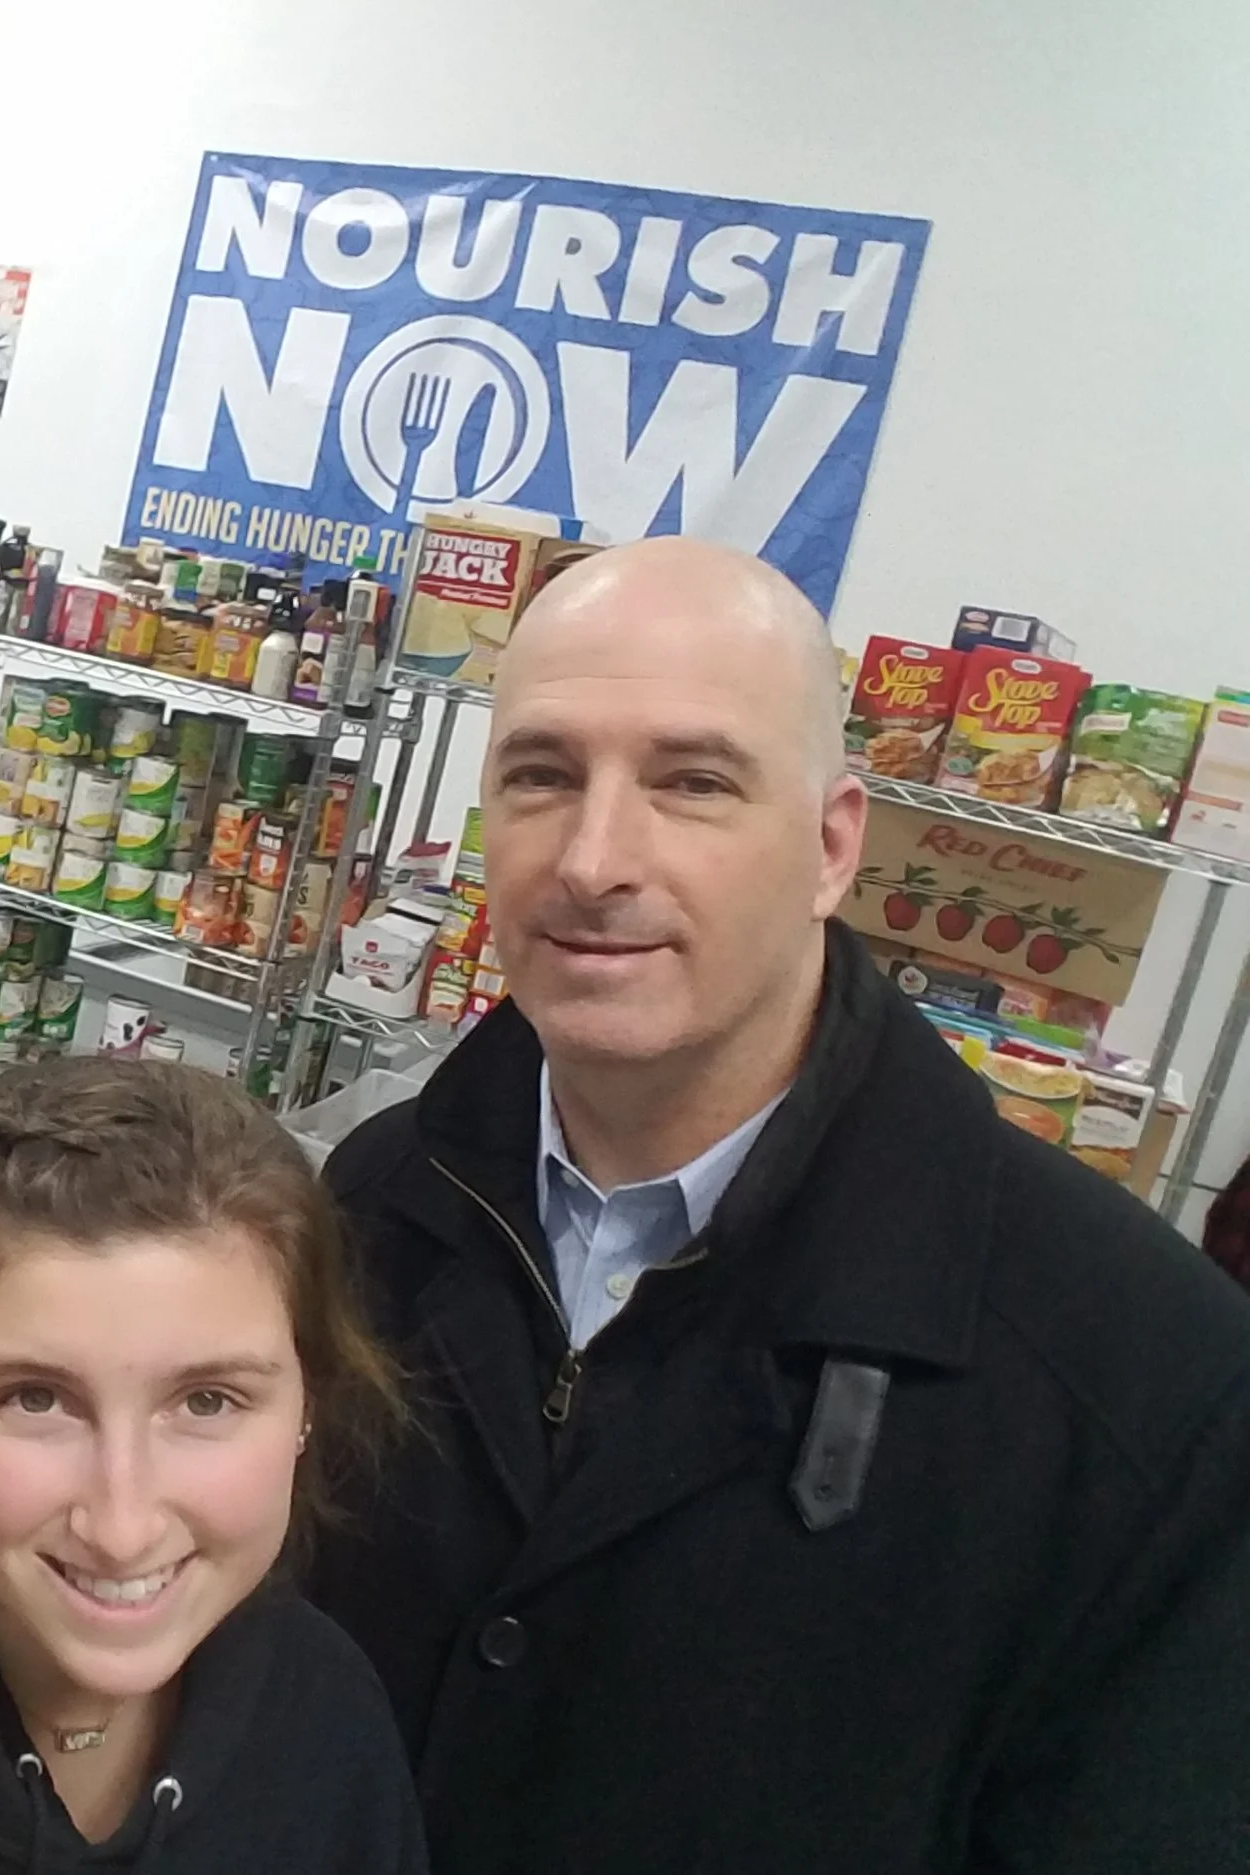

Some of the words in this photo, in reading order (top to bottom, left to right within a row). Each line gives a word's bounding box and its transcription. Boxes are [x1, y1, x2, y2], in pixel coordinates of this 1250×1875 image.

[196, 174, 905, 356] NOURISH
[152, 295, 869, 560] NOW
[140, 487, 242, 545] ENDING
[246, 505, 371, 566] HUNGER
[376, 529, 410, 575] TH
[425, 532, 513, 559] HUNGRY
[420, 551, 511, 586] JACK
[350, 955, 390, 971] TACO
